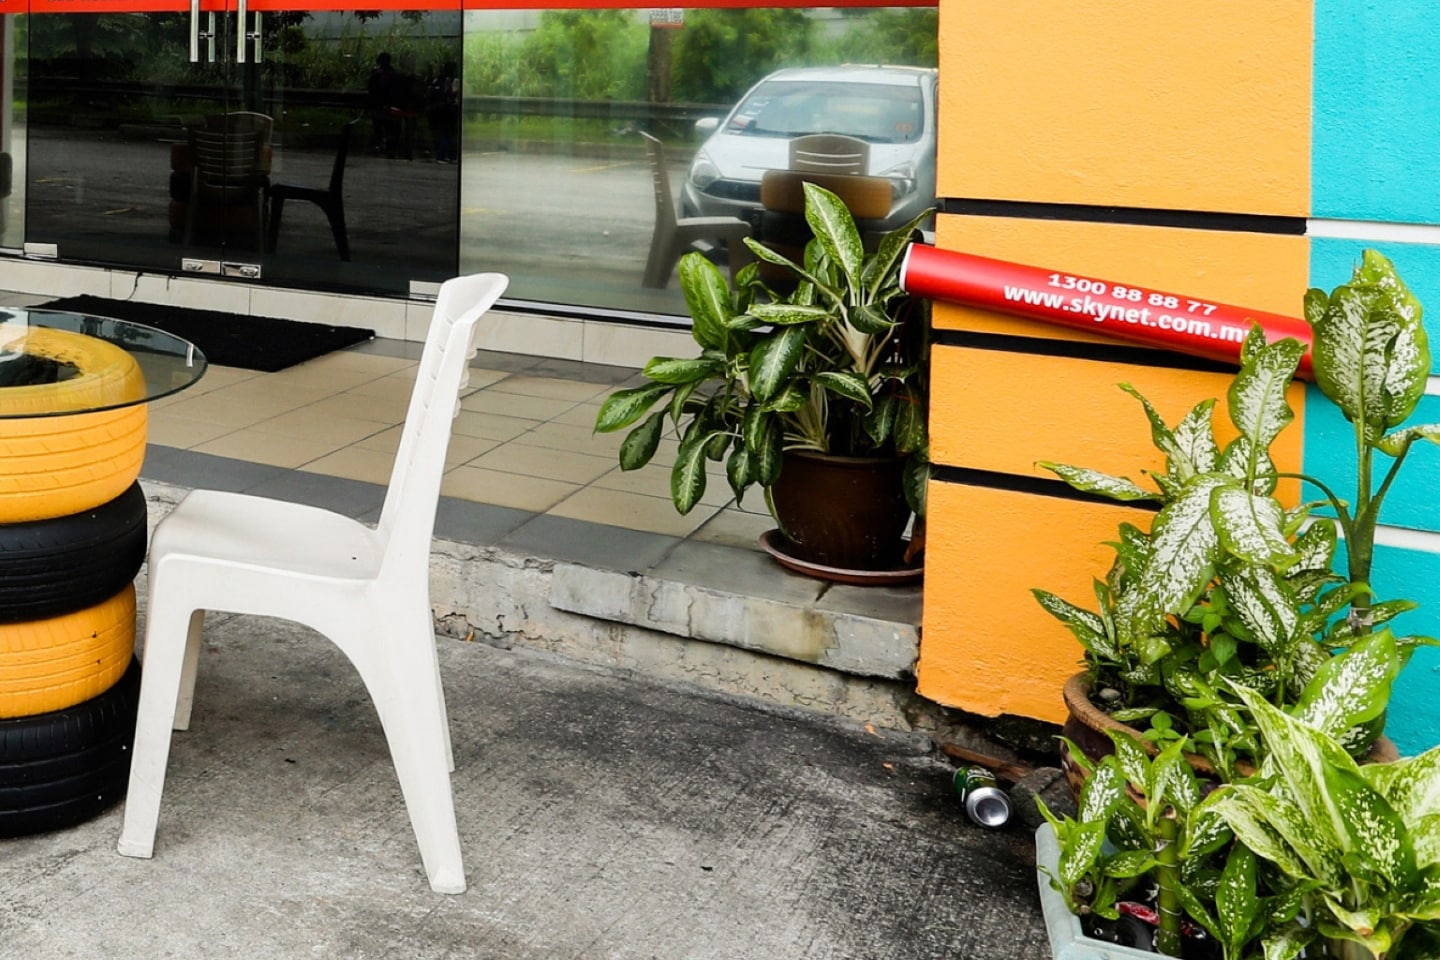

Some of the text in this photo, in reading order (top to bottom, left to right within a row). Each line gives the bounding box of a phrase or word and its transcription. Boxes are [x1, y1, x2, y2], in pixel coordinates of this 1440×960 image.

[1048, 273, 1219, 316] 1300 88 88 77
